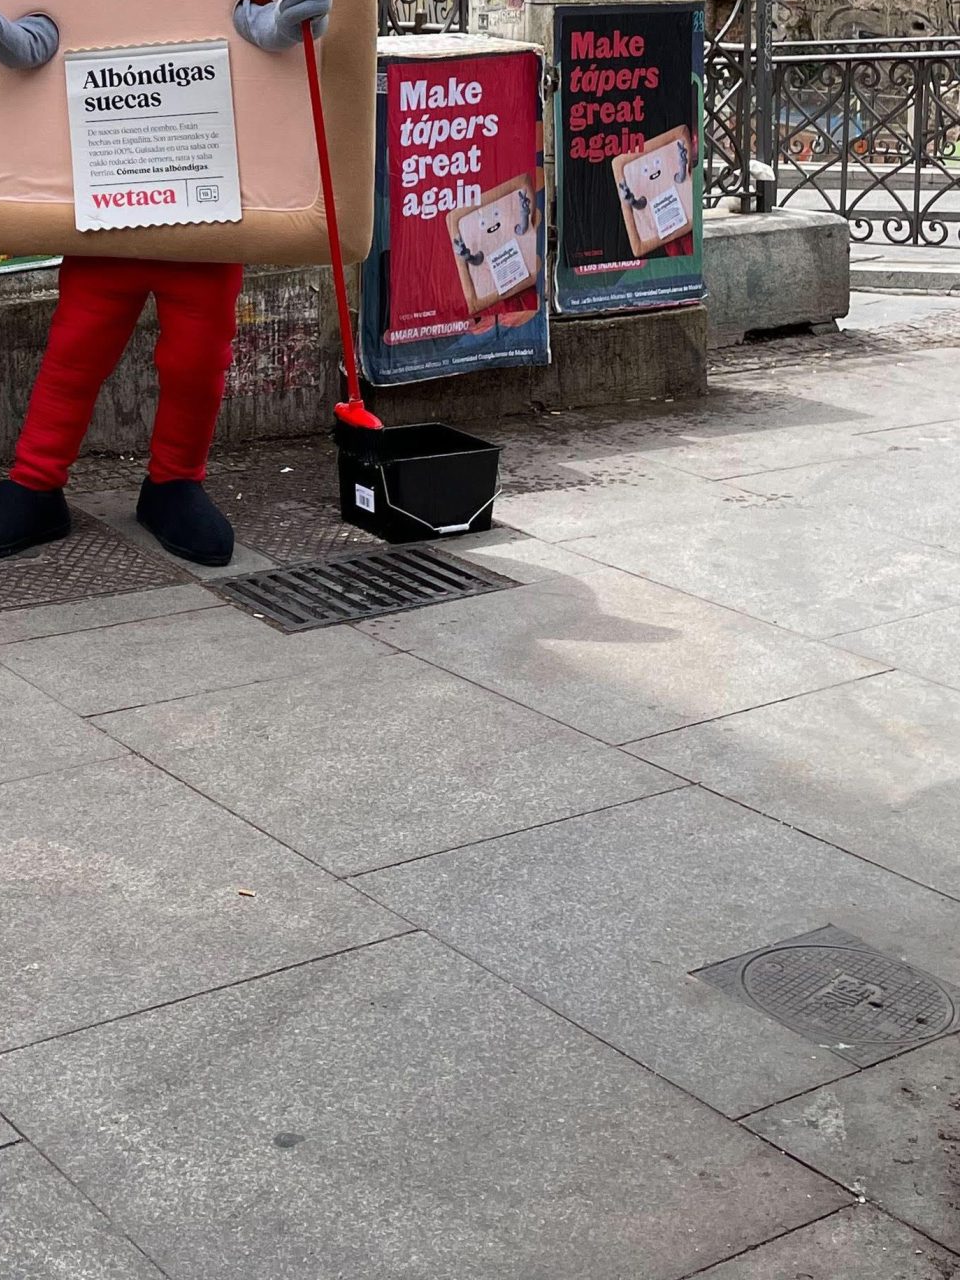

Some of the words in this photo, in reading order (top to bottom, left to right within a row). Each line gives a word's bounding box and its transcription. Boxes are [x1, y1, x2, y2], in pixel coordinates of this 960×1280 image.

[694, 11, 705, 20] 20
[694, 23, 705, 32] 23
[570, 30, 645, 61] Make
[83, 62, 215, 89] Albóndigas
[570, 64, 659, 97] tápers
[84, 91, 162, 112] suecas
[399, 76, 483, 111] Make
[570, 95, 645, 132] great
[400, 114, 499, 153] tápers
[570, 131, 646, 163] again
[116, 167, 151, 176] Cómeme
[401, 147, 481, 187] great
[92, 188, 176, 208] wetaca
[402, 181, 482, 220] again
[420, 320, 470, 337] PORTUONDO
